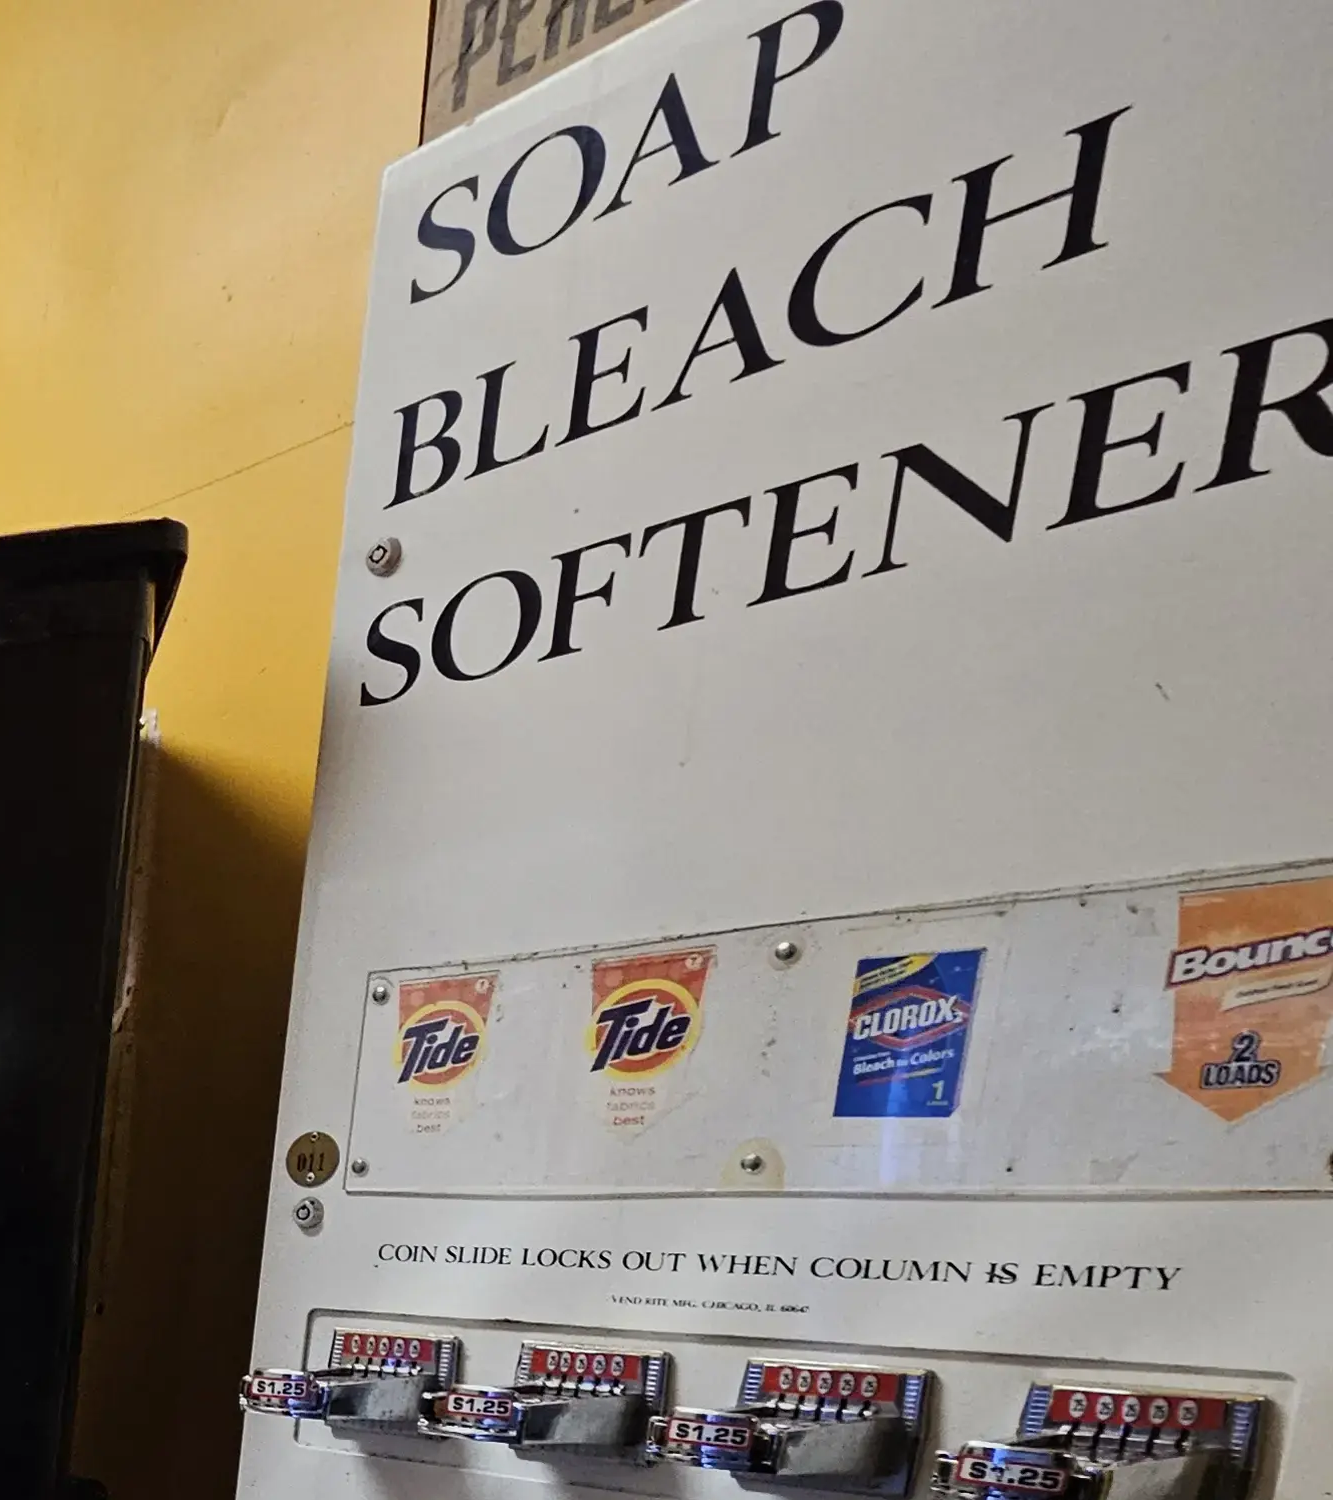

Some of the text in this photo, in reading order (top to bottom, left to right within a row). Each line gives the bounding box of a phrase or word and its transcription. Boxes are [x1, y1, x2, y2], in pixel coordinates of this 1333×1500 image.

[410, 0, 845, 304] SOAP
[383, 105, 1133, 510] BLEACH
[359, 317, 1333, 708] SOFTENER
[1171, 929, 1333, 985] Bounc
[590, 996, 693, 1074] Tide
[1234, 1033, 1257, 1064] 2
[397, 1015, 481, 1085] Tide
[852, 1057, 895, 1076] Bleach
[909, 1048, 956, 1066] Colors
[1202, 1062, 1280, 1088] LOADS
[609, 1085, 657, 1098] knows
[931, 1079, 945, 1100] 1
[416, 1123, 443, 1134] best
[612, 1115, 646, 1128] best
[296, 1152, 326, 1173] 011
[378, 1243, 1183, 1291] COIN SLIDE LOCKS OUT WHEN COLUMN IS EMPTY
[255, 1378, 306, 1397] $1.25
[451, 1395, 511, 1415] $1.25
[674, 1421, 747, 1446] $1.25
[968, 1460, 1063, 1490] $1.25
